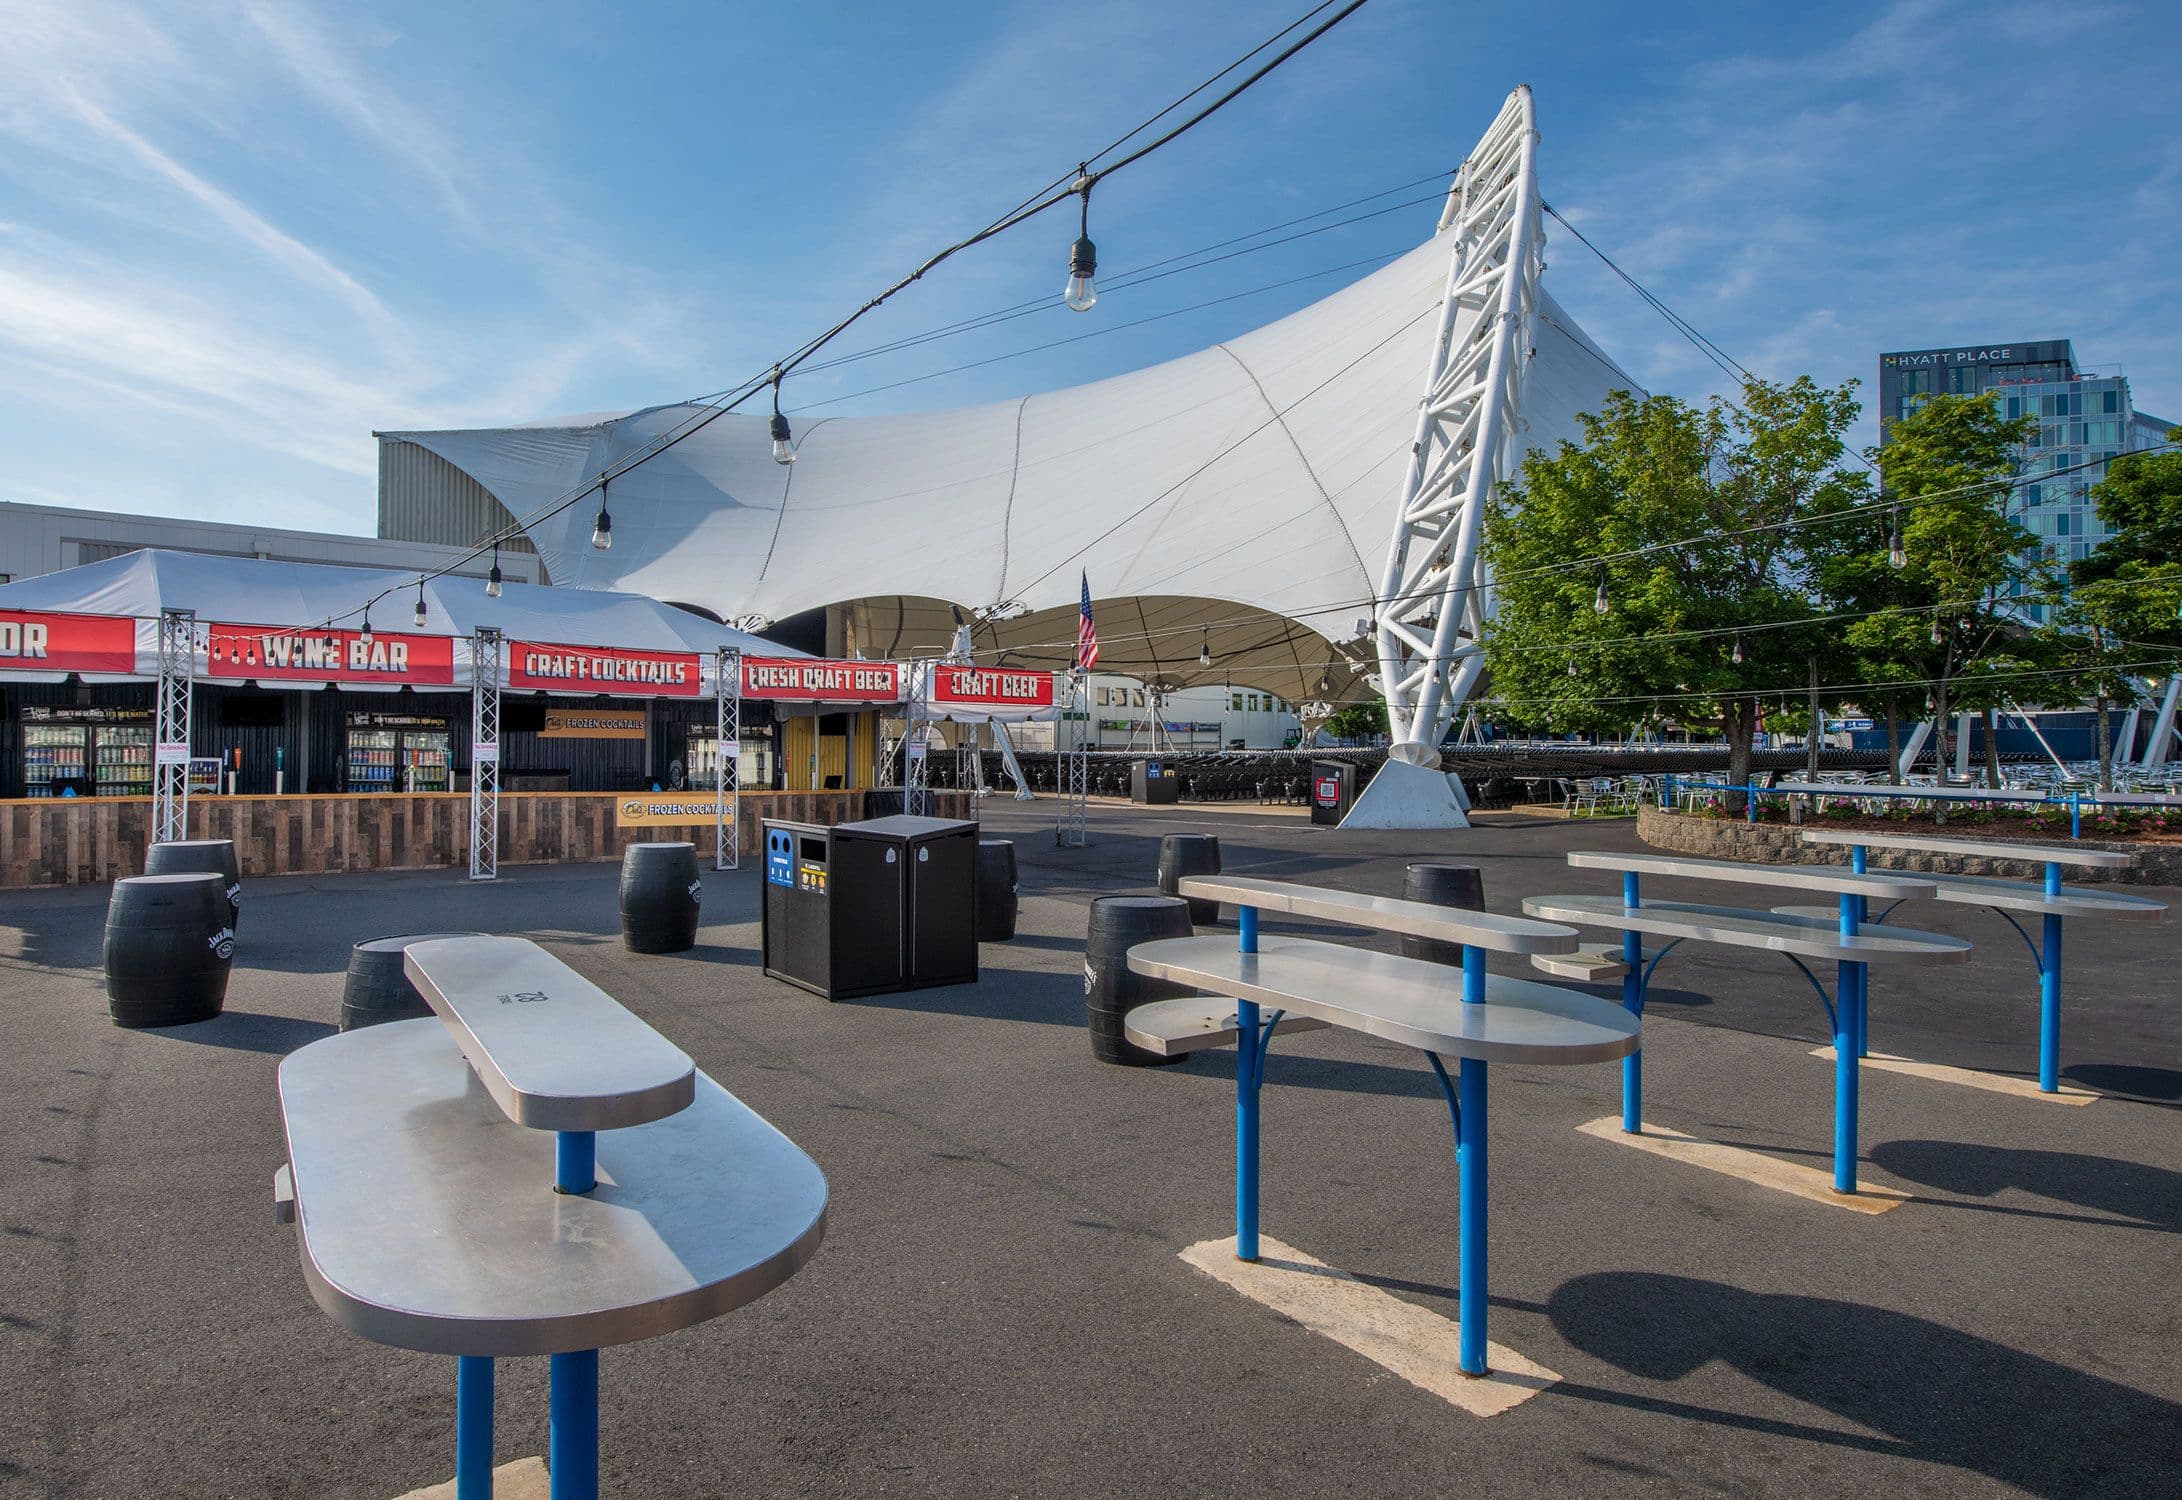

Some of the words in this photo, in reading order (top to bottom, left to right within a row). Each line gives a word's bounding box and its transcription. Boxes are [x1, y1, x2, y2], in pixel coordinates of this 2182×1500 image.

[1899, 353, 1950, 366] HYATT
[1957, 349, 2011, 361] PLACE
[262, 635, 341, 669] WINE
[349, 639, 408, 672] BAR
[526, 653, 586, 679] CRAFT
[591, 658, 685, 685] COCKTAILS
[749, 665, 799, 688] FRESH
[803, 667, 851, 689] DRAFT
[856, 669, 892, 691] BEER
[952, 671, 998, 696] CRAFT
[1002, 674, 1038, 698] BEER
[566, 719, 598, 728] FROZEN
[601, 719, 645, 729] COCKTAILS
[648, 804, 684, 815] FROZEN
[685, 804, 734, 815] COCKTALS
